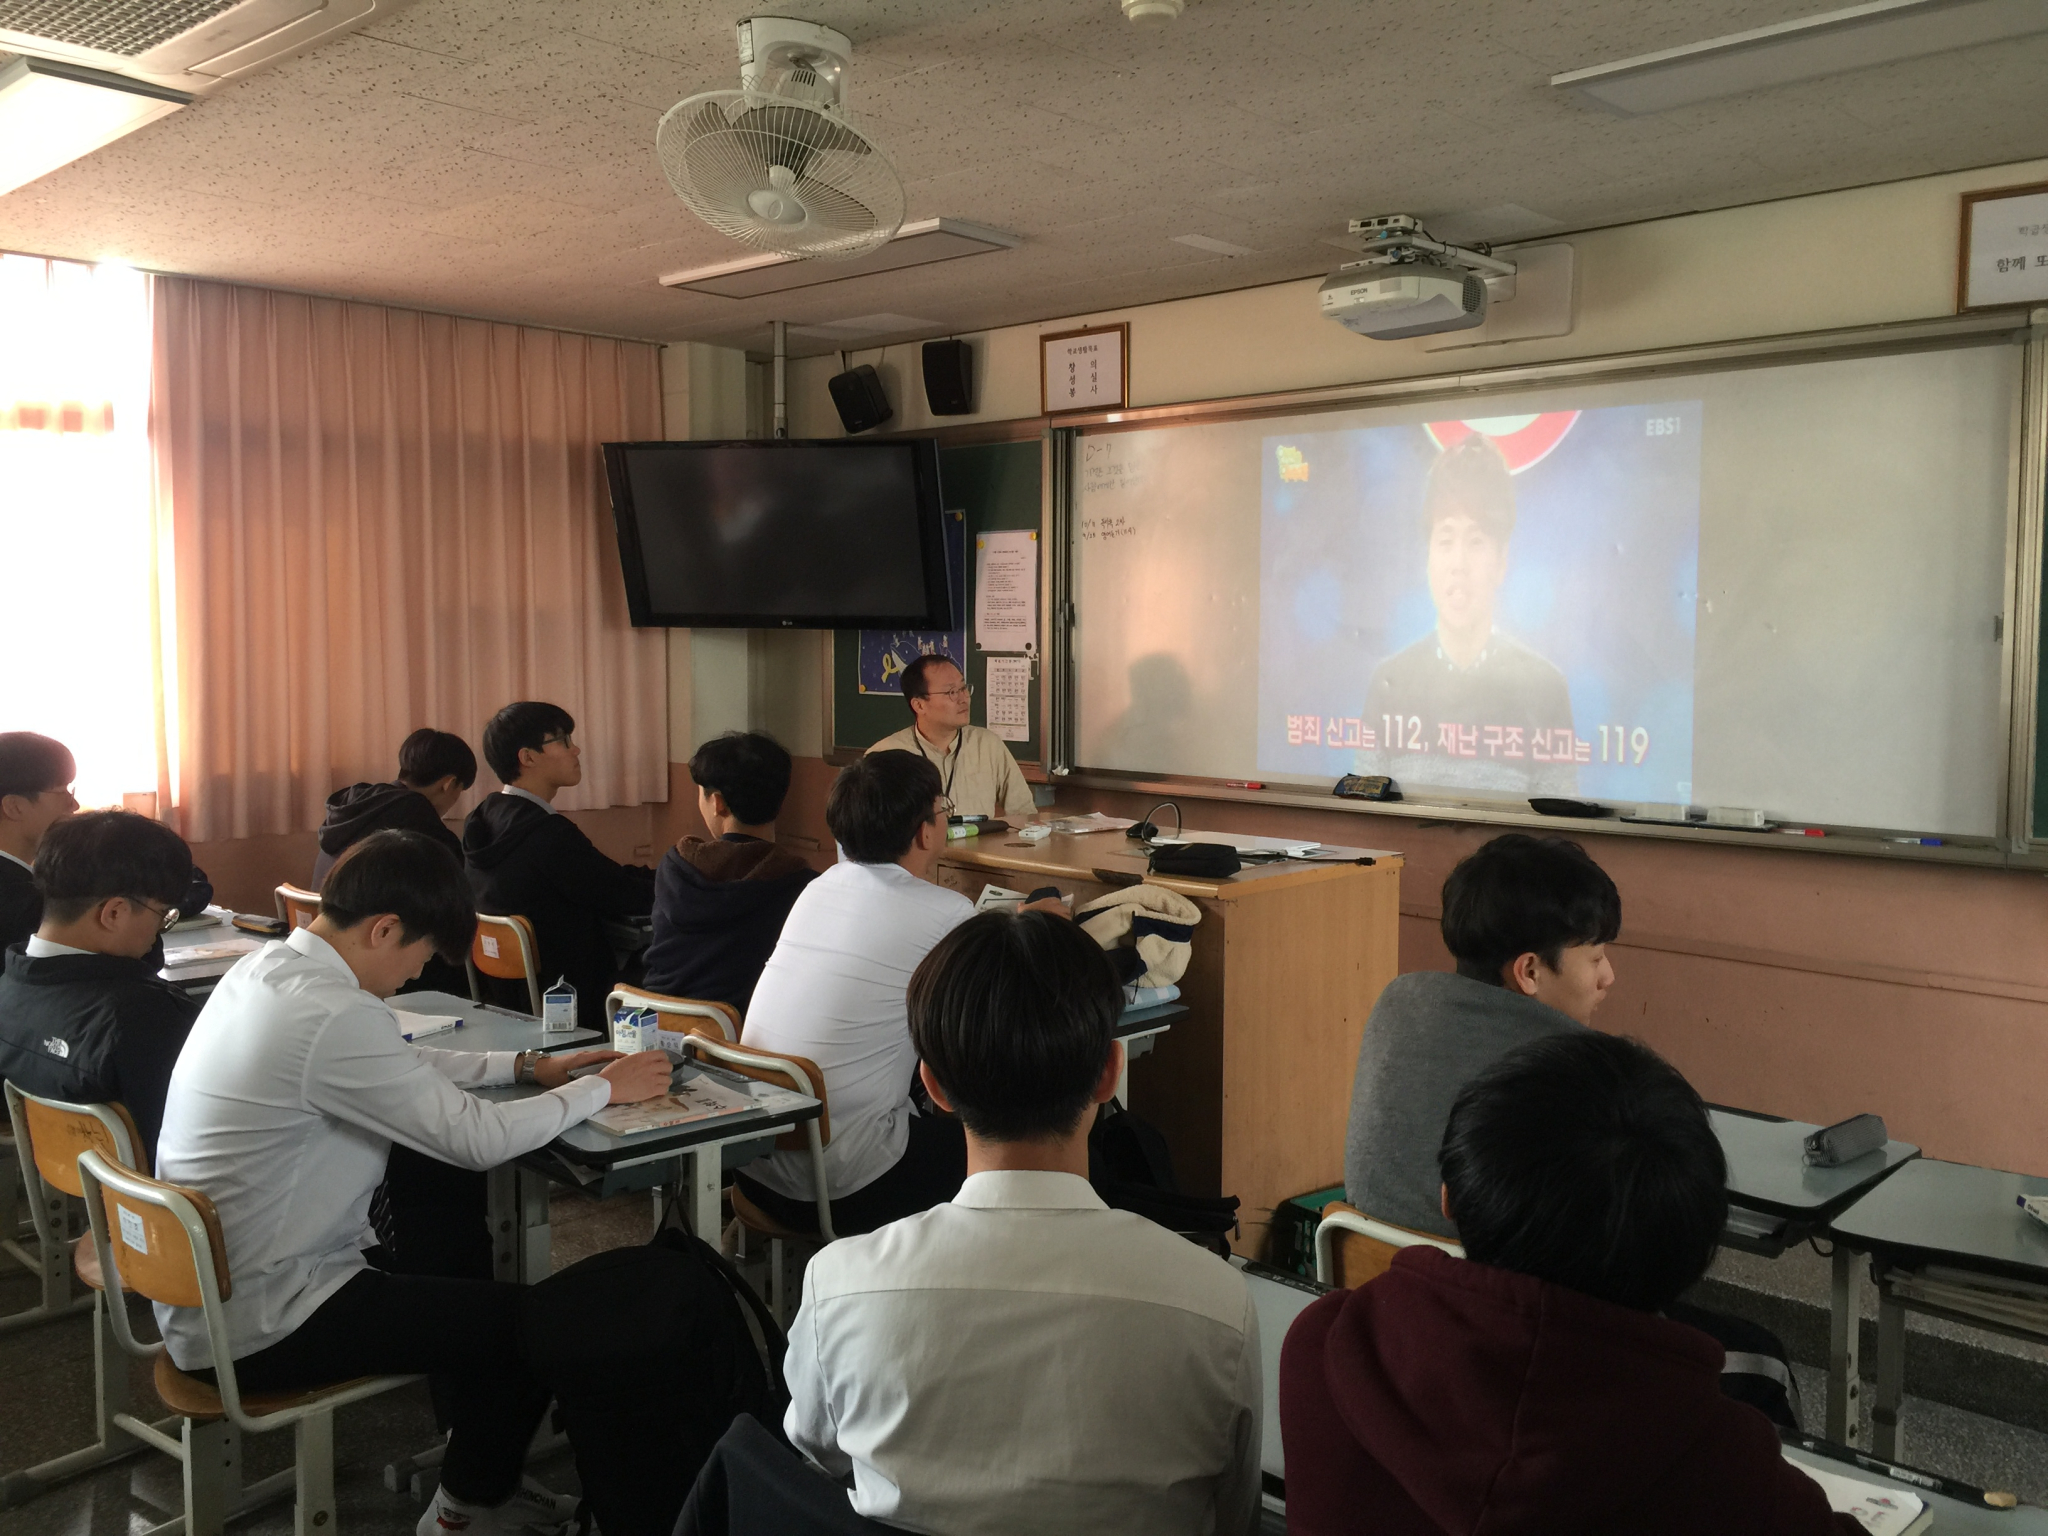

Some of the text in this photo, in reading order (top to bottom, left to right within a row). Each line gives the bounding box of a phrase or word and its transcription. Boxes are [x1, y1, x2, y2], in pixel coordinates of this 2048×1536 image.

[1997, 256, 2026, 273] 함께
[1350, 288, 1368, 296] EPSON
[1646, 417, 1681, 436] EBS1
[1286, 712, 1650, 765] 범죄 신고는 112, 재난 구조 신고는 119
